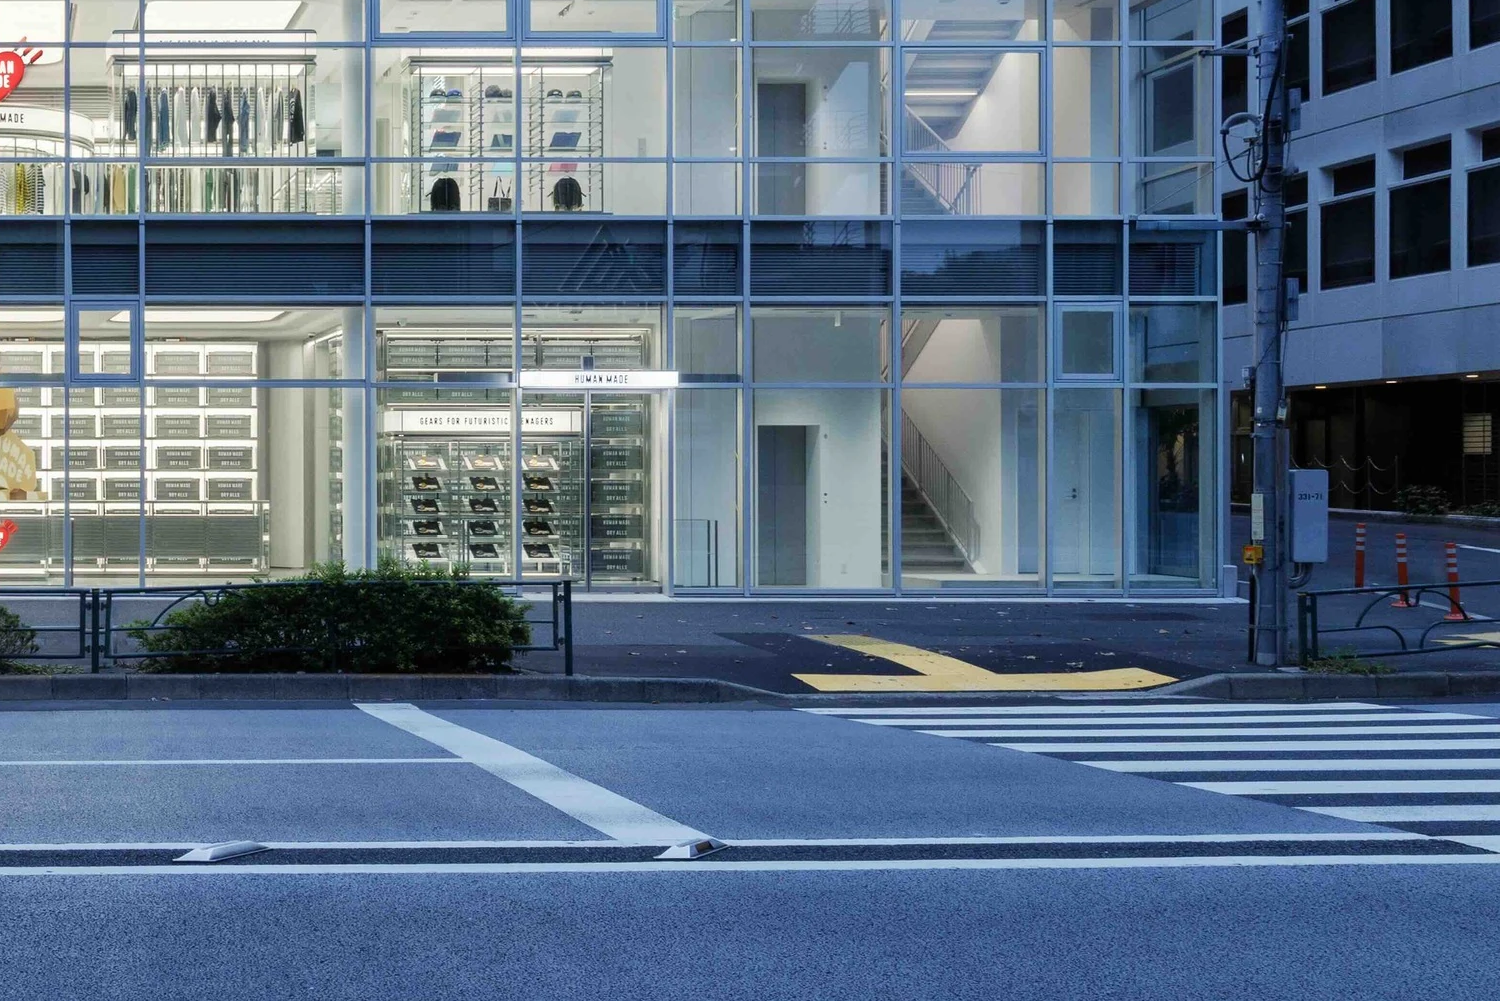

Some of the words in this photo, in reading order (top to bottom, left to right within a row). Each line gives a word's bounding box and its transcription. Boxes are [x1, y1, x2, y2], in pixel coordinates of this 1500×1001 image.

[0, 113, 24, 123] MADE
[575, 374, 603, 384] HUMAN
[605, 374, 628, 384] MADE
[419, 417, 443, 425] GEARS
[447, 417, 460, 425] FOR
[464, 417, 510, 425] FUTURISTIC
